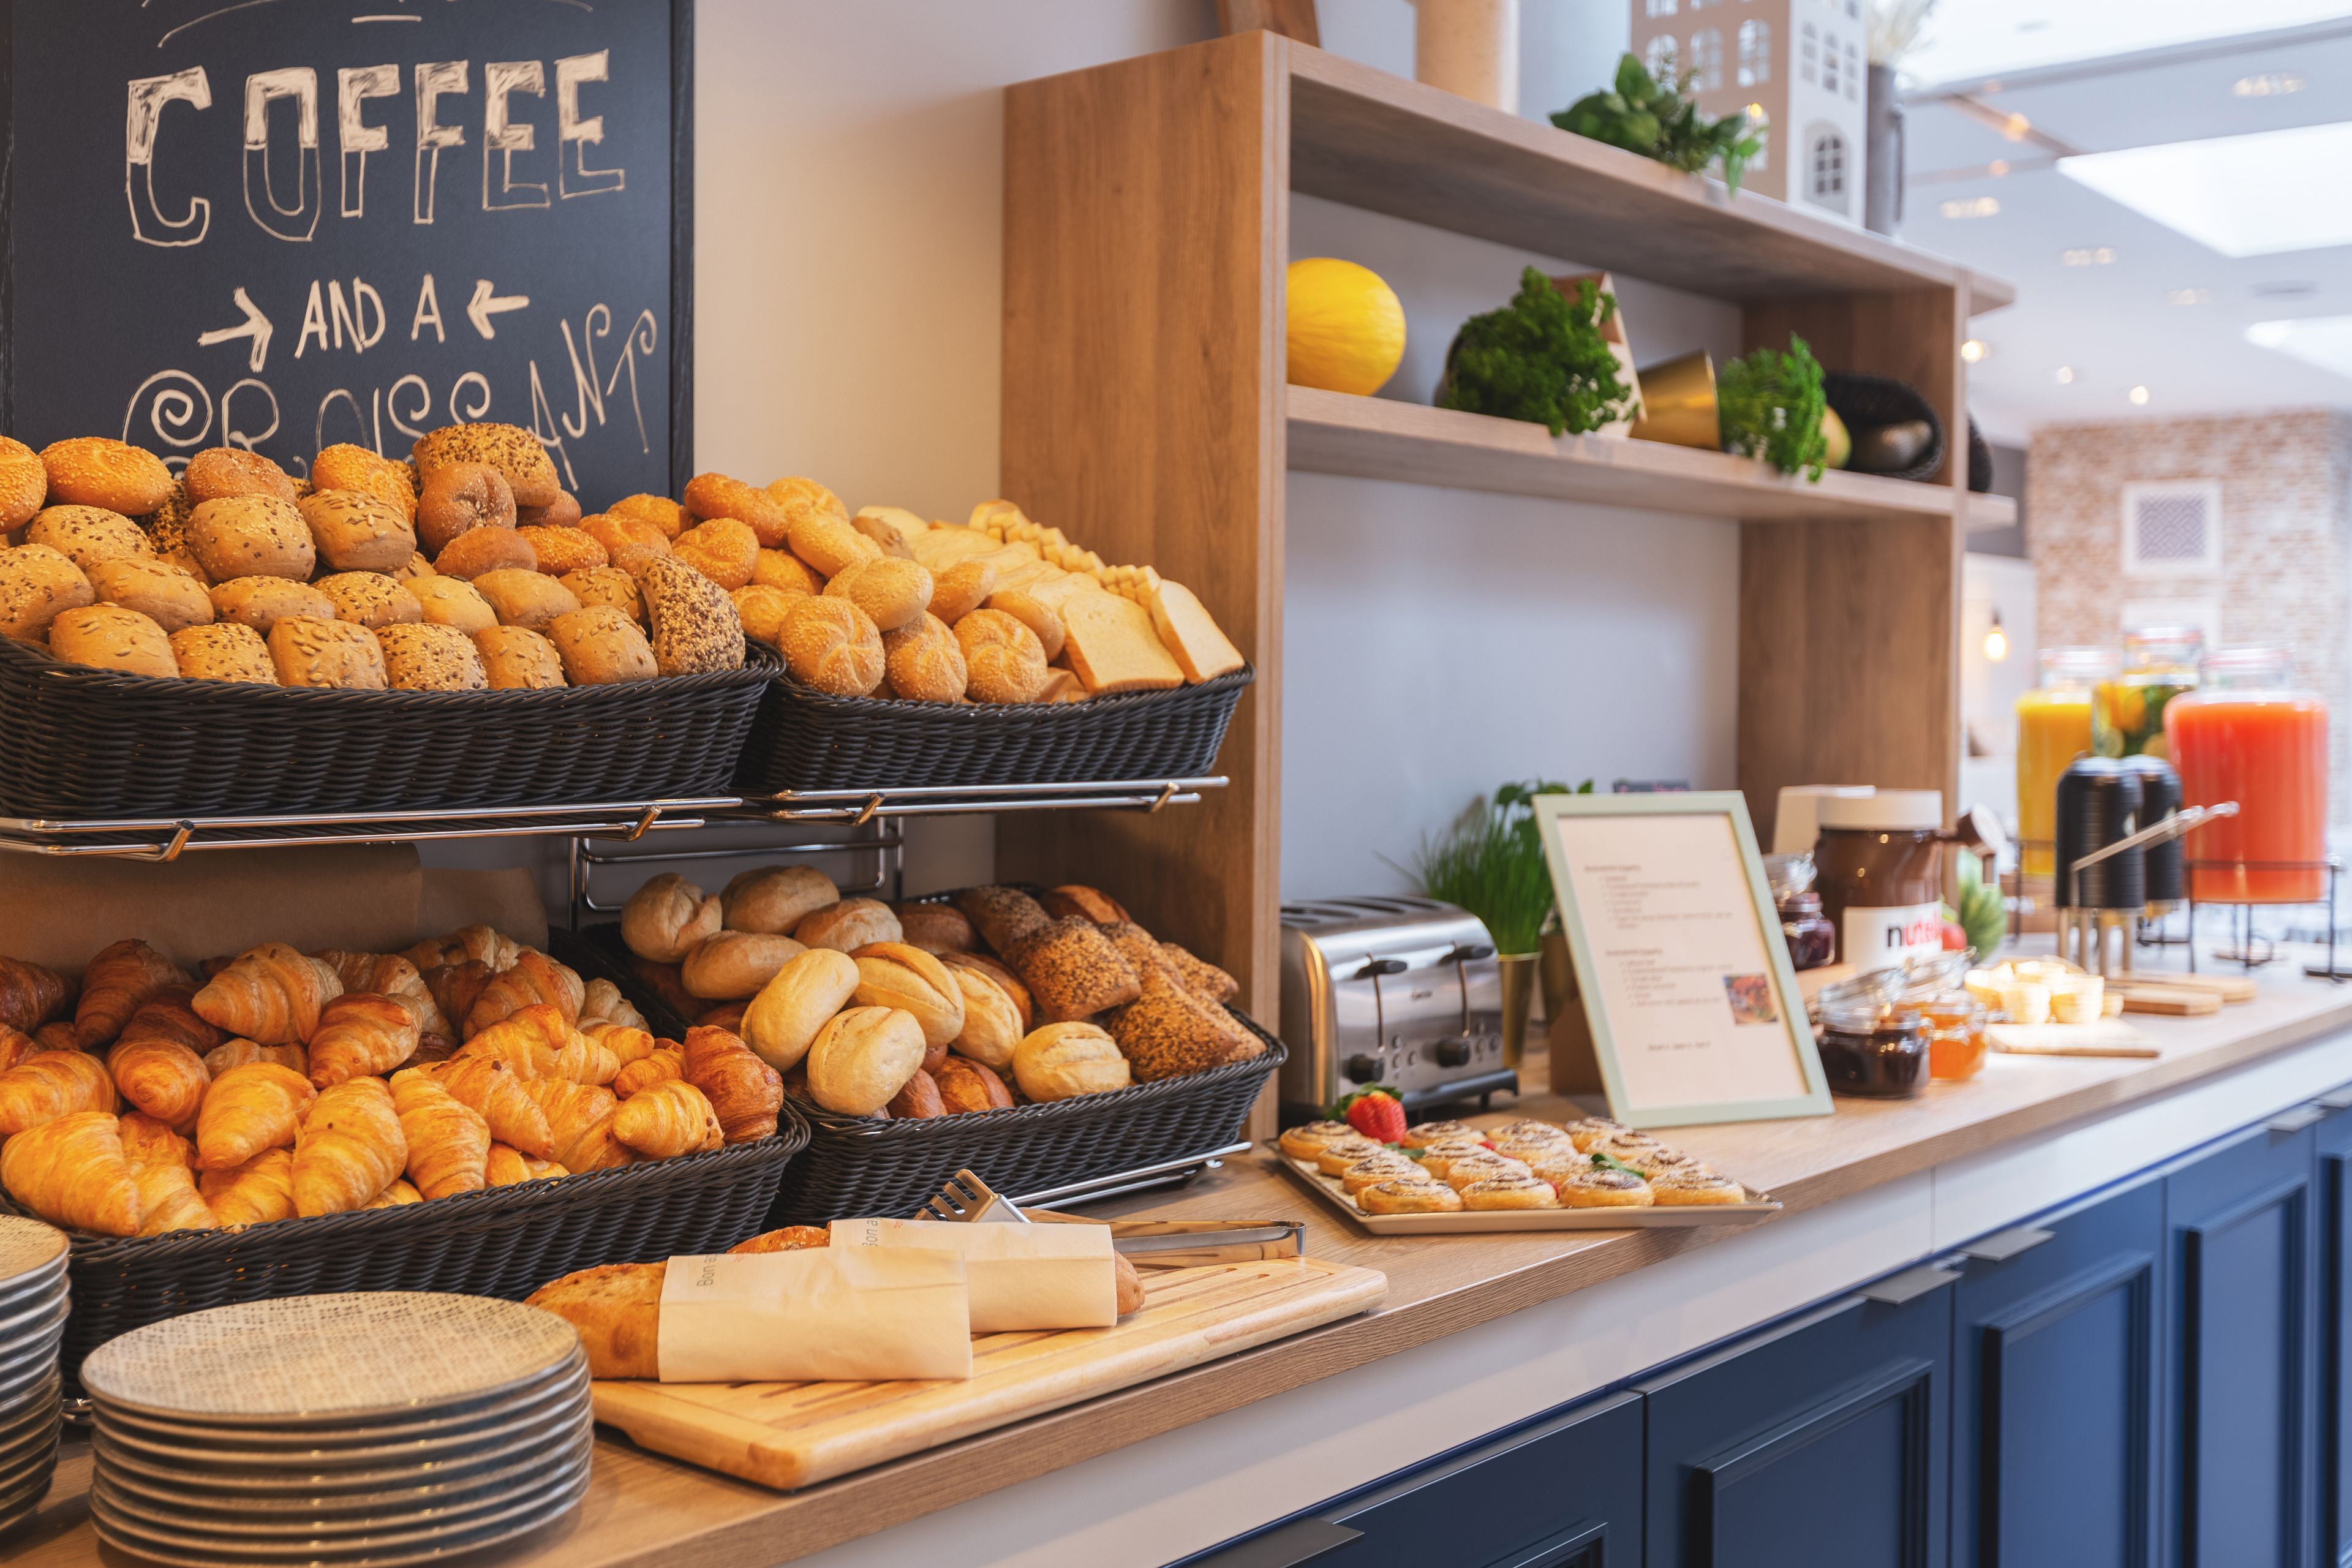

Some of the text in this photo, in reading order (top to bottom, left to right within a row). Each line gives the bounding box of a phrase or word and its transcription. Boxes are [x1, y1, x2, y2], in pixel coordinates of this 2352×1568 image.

[126, 48, 625, 247] COFFEE
[295, 272, 445, 359] AND A
[696, 1264, 715, 1287] Bon
